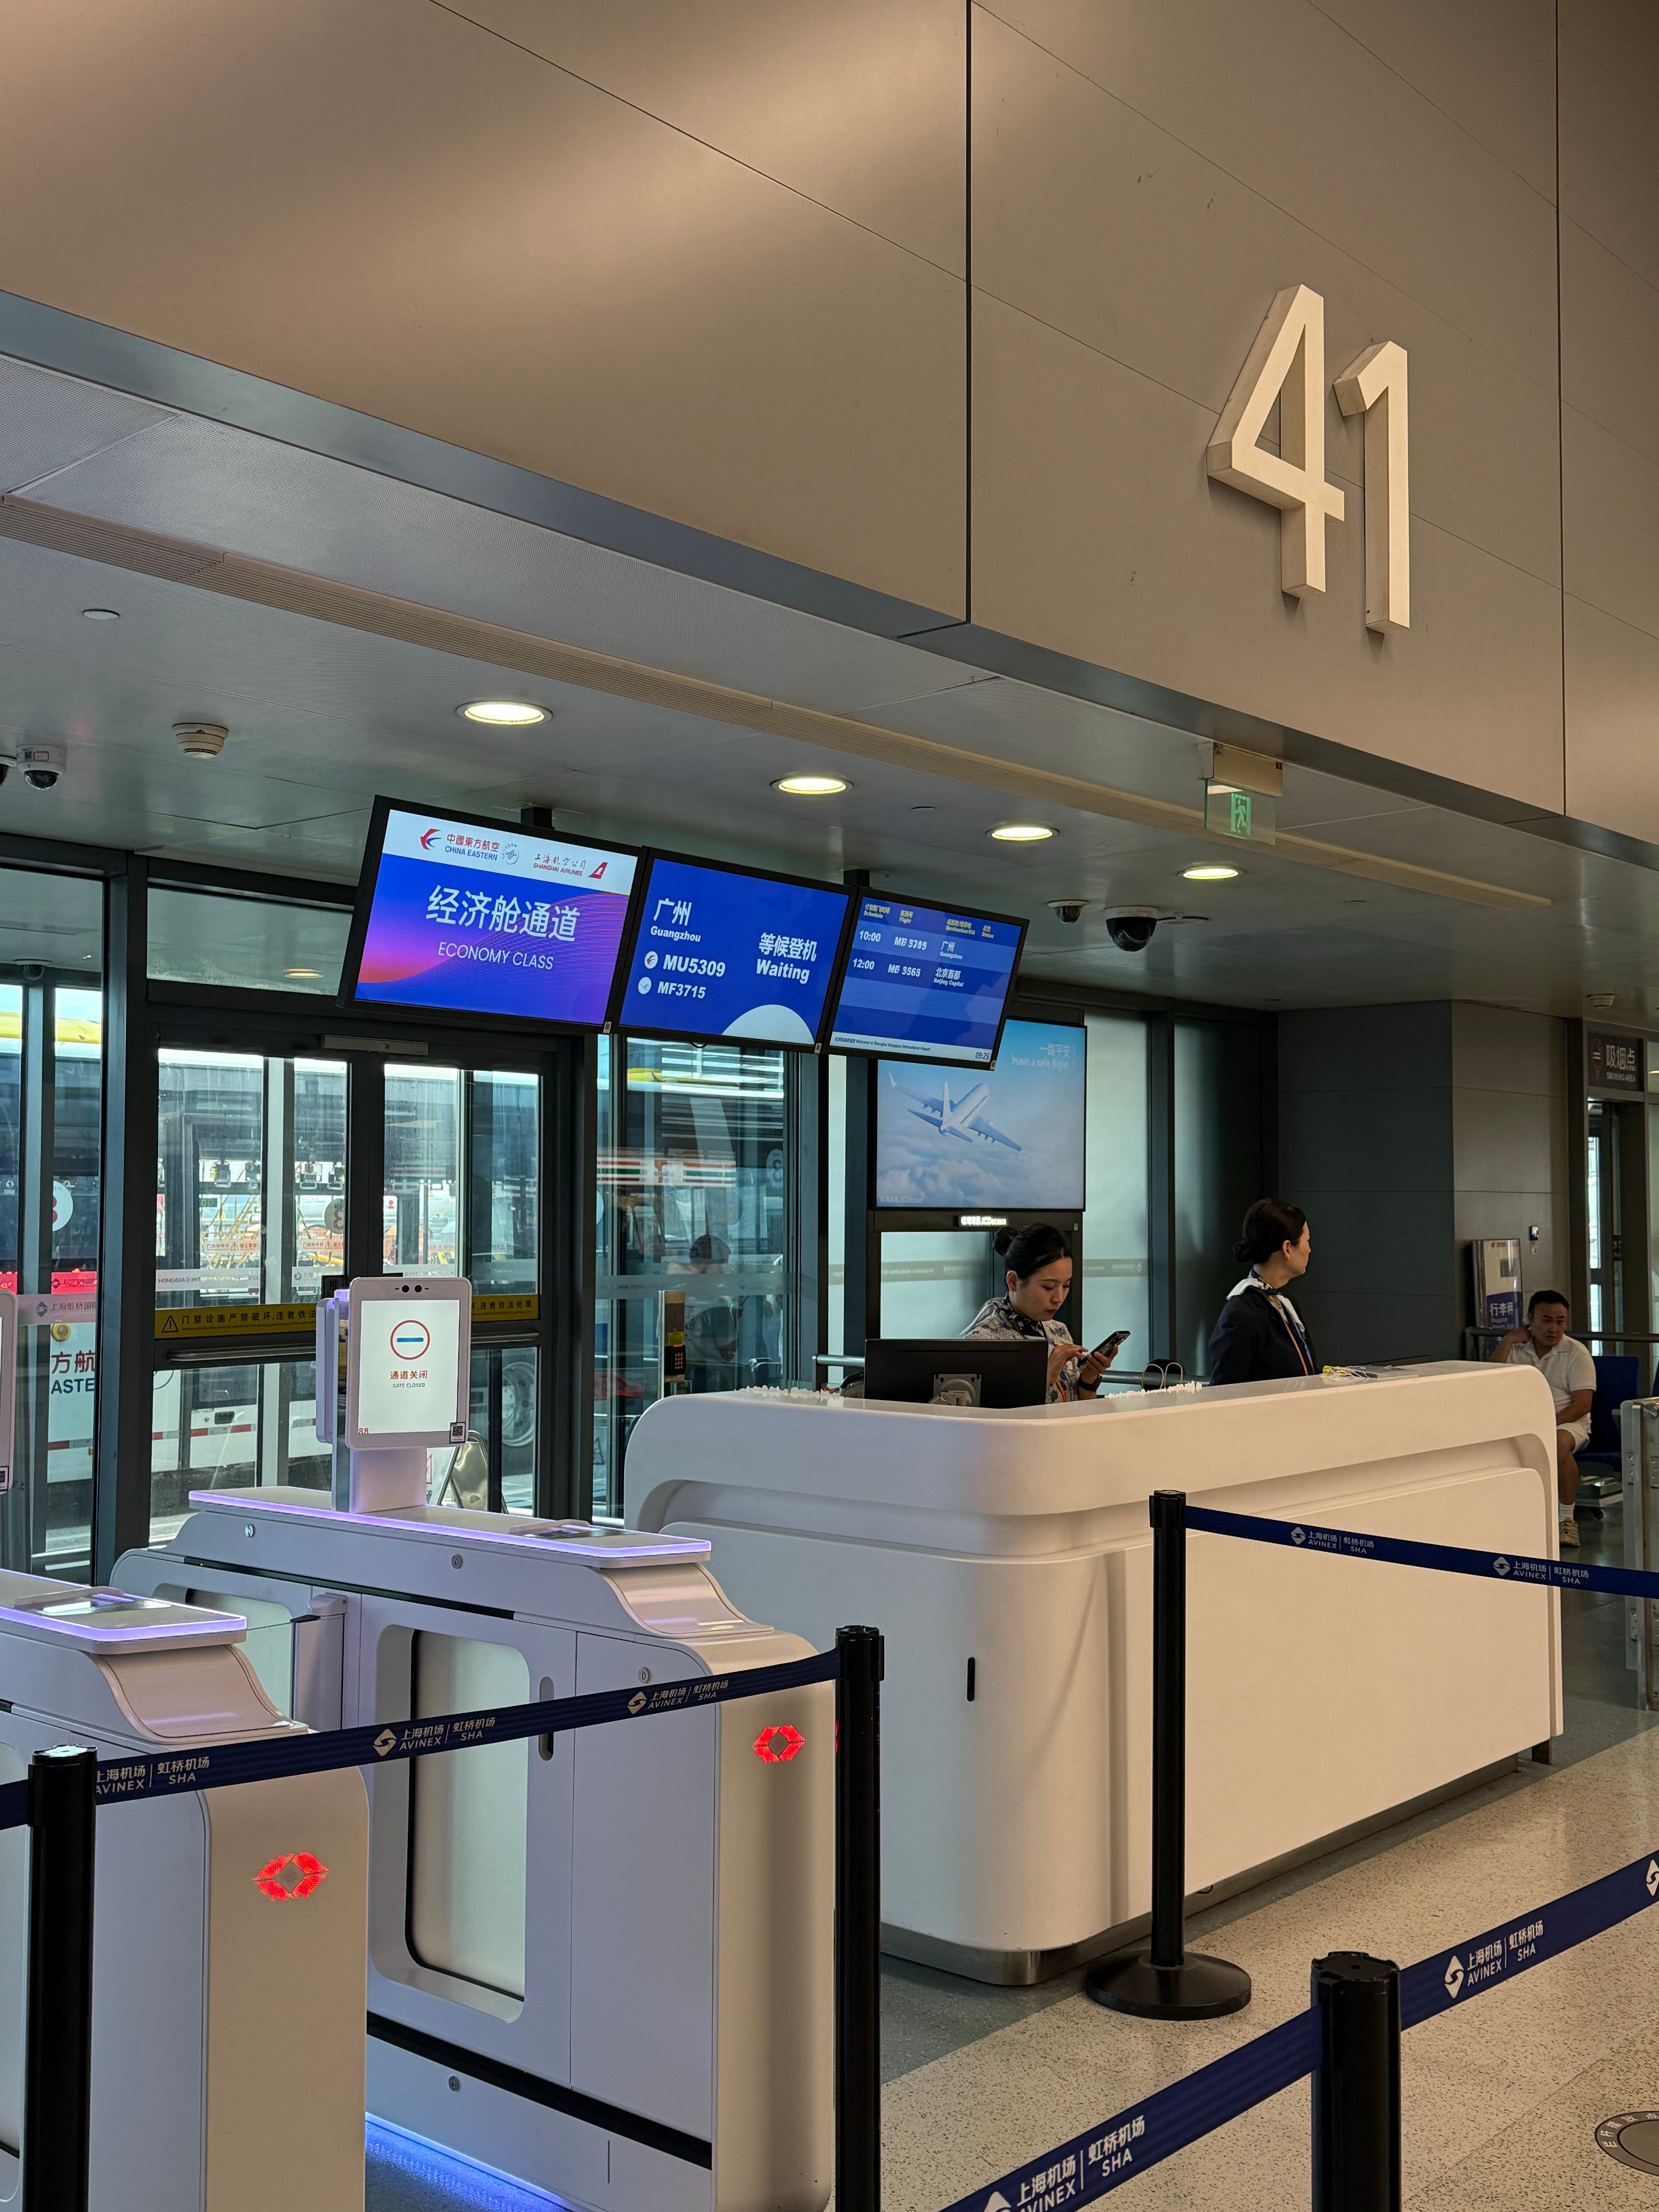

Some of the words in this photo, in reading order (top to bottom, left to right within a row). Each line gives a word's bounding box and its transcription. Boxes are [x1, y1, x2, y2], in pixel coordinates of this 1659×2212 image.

[1207, 284, 1410, 635] 41
[447, 834, 499, 852] 中國東方航空
[445, 846, 465, 856] CHINA
[467, 850, 498, 860] EASTERN
[535, 853, 586, 869] 上海航空公司
[533, 863, 559, 872] SHANGHAI
[560, 868, 583, 876] AIRLINES
[426, 885, 580, 941] 经济舱通道
[653, 898, 692, 926] 广州
[651, 926, 701, 942] Guangzhou
[859, 931, 881, 942] 10:00
[438, 942, 510, 964] ECONOMY
[513, 952, 554, 969] CLASS
[759, 933, 817, 962] 等候登机
[940, 951, 962, 960] Guangzhou
[941, 941, 955, 952] 广州
[663, 955, 725, 977] MU5309
[756, 959, 810, 984] Waiting
[853, 958, 874, 970] 12:00
[935, 967, 961, 980] 北京首都
[658, 981, 706, 999] MF3715
[1012, 1054, 1030, 1066] Have
[1606, 1045, 1636, 1072] 吸烟点
[51, 1350, 95, 1374] 方航
[390, 1370, 428, 1379] 通道关闭
[51, 1378, 94, 1394] ASTE
[1308, 1531, 1337, 1542] 上海机场
[1343, 1537, 1374, 1548] 虹桥机场
[1308, 1539, 1337, 1549] AVINEX
[1513, 1561, 1546, 1573] 上海机场
[1554, 1566, 1589, 1578] 虹桥机场
[1513, 1570, 1546, 1580] AVINEX
[1562, 1577, 1581, 1585] SHA
[650, 1687, 687, 1701] 上海机场
[693, 1680, 729, 1694] 虹桥机场
[647, 1697, 684, 1709] AVINEX
[698, 1692, 716, 1700] SHA
[401, 1724, 444, 1740] 上海机场
[452, 1717, 495, 1733] 虹桥机场
[399, 1737, 441, 1751] AVINEX
[460, 1730, 483, 1741] SHA
[97, 1765, 146, 1783] 上海机场
[157, 1756, 209, 1774] 虹桥机场
[96, 1779, 144, 1794] AVINEX
[169, 1772, 196, 1784] SHA
[1467, 1940, 1502, 1970] 上海机场
[1510, 1920, 1543, 1950] 虹桥机场
[1467, 1958, 1502, 1987] AVINEX
[1517, 1943, 1535, 1961] SHA
[1017, 2154, 1076, 2207] 上海机场
[1088, 2115, 1145, 2165] 虹桥机场
[1102, 2148, 1133, 2177] SHA
